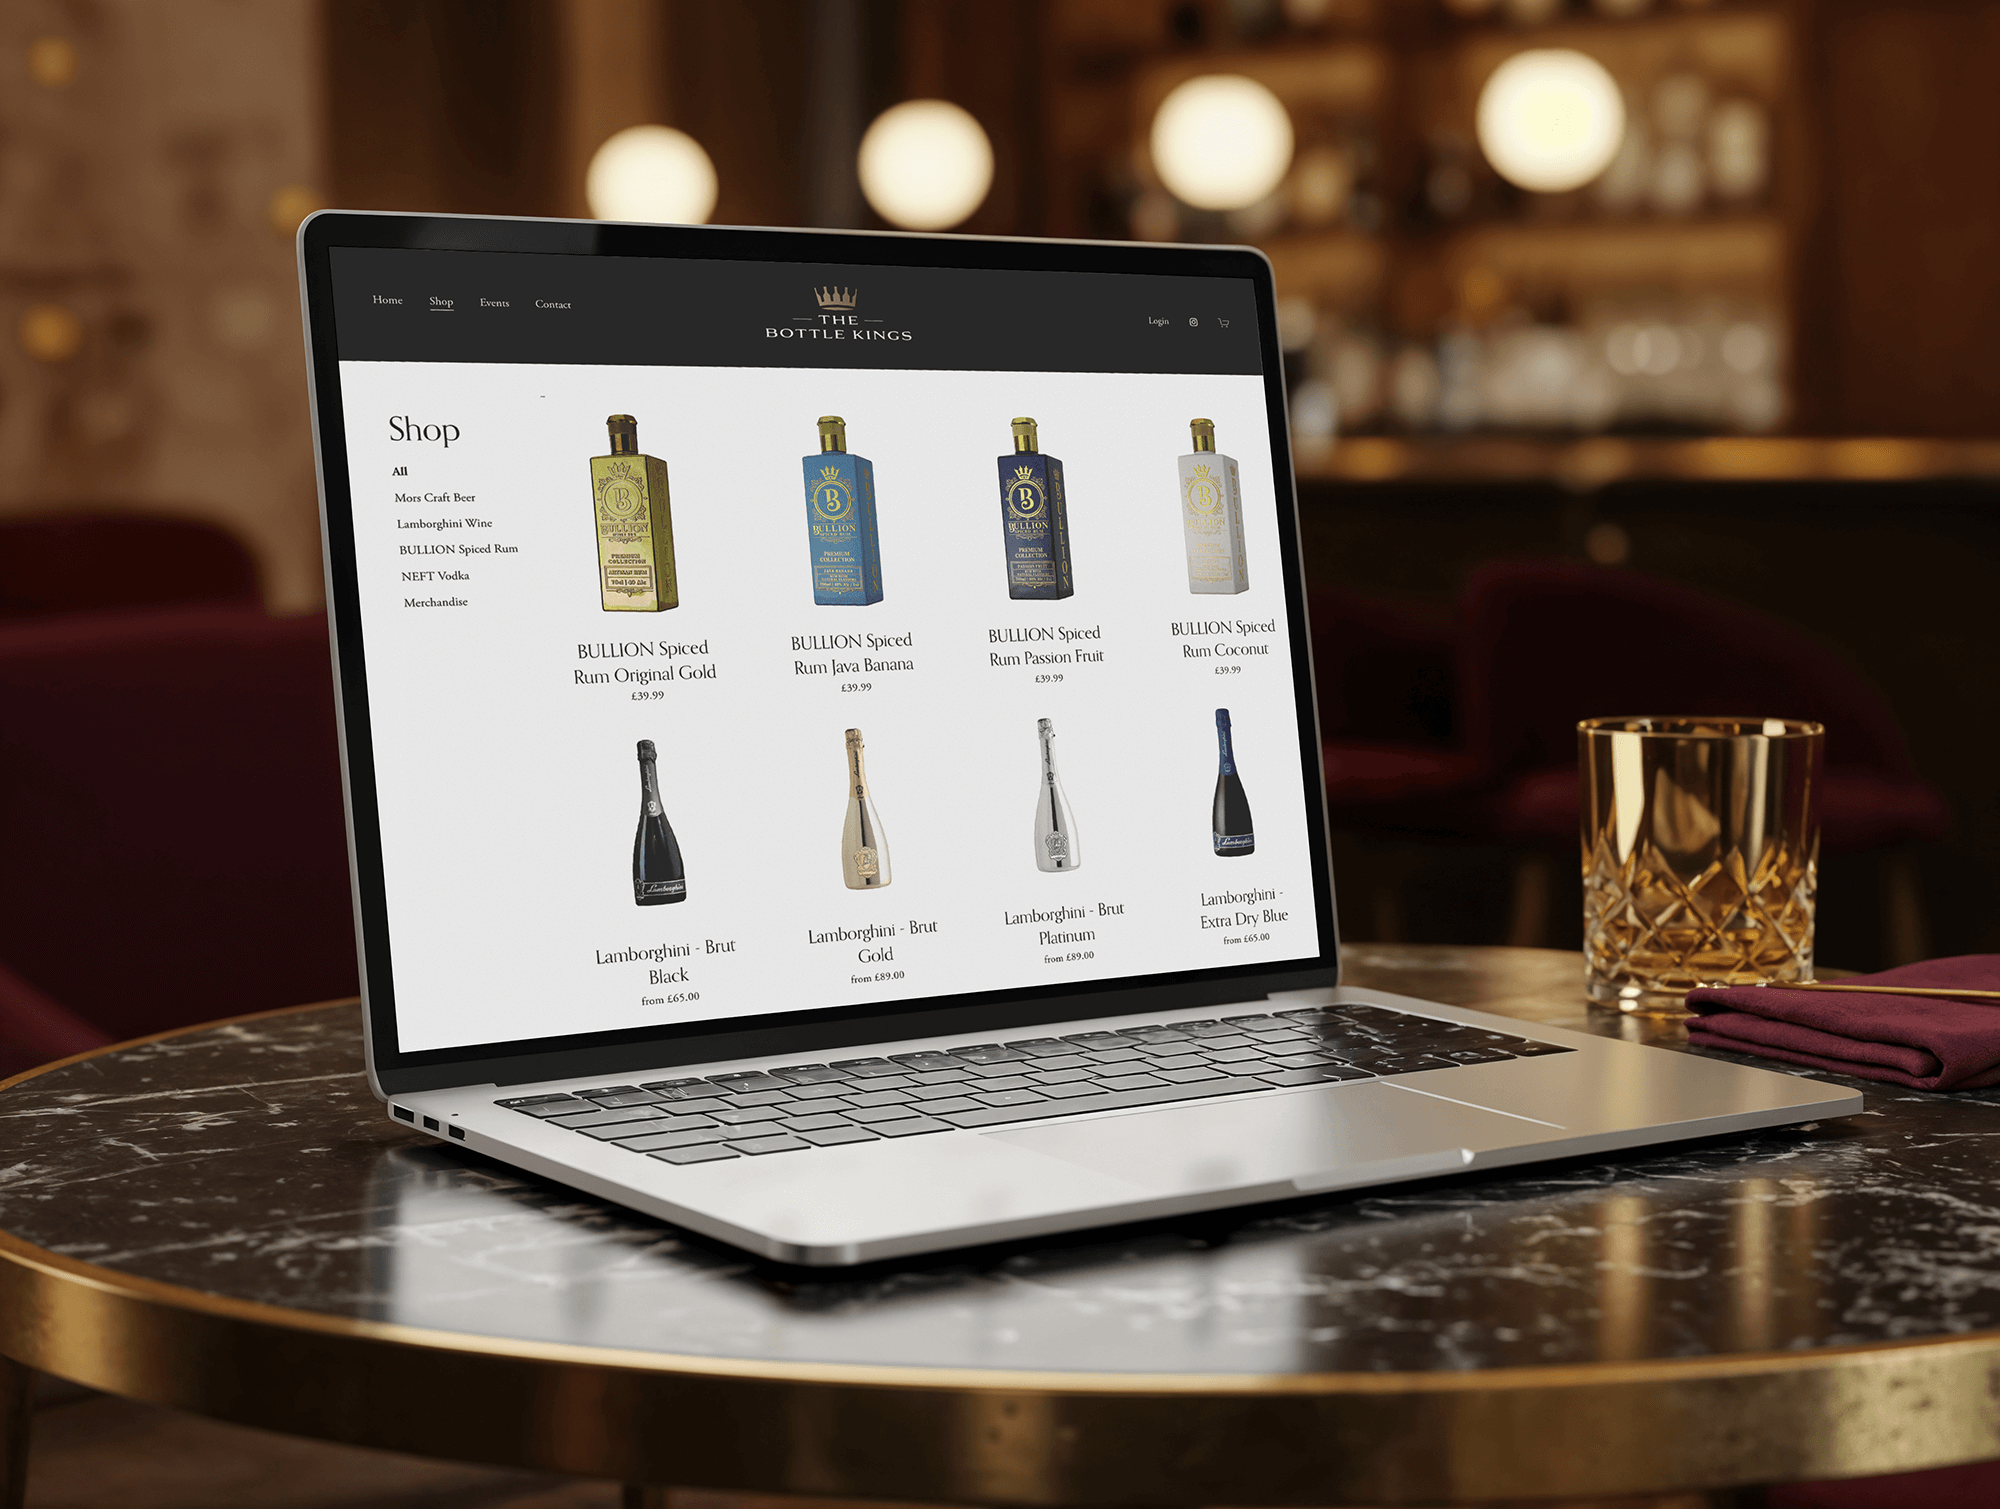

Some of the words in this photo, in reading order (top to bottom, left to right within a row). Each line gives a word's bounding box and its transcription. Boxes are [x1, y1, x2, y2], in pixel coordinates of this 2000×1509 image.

[373, 295, 403, 305] Home
[429, 296, 455, 309] Shop
[480, 297, 510, 308] Events
[535, 299, 572, 309] Contact
[818, 313, 859, 325] THE
[1148, 316, 1170, 328] Login
[765, 327, 846, 340] BOTTLE
[853, 329, 913, 342] KINGS
[389, 415, 461, 449] Shop
[392, 466, 409, 477] All
[395, 493, 422, 503] Mors
[424, 492, 451, 503] Craft
[454, 492, 476, 502] Beer
[397, 518, 463, 532] Lamborghini
[465, 517, 493, 528] Wine
[600, 524, 649, 536] BULLION
[813, 524, 857, 536] BULLION
[1008, 521, 1050, 533] BULLION
[1186, 518, 1226, 530] BULLION
[399, 545, 456, 556] BULLION
[458, 544, 492, 557] Spiced
[494, 543, 519, 554] Rum
[401, 571, 435, 582] NEFT
[438, 570, 470, 581] Vodka
[404, 596, 469, 608] Merchandise
[988, 627, 1054, 644] BULLION
[1058, 625, 1101, 644] Spiced
[1171, 621, 1233, 636] BULLION
[1236, 619, 1276, 637] Spiced
[791, 634, 862, 651] BULLION
[866, 632, 913, 652] Spiced
[577, 642, 654, 660] BULLION
[658, 640, 709, 660] Spiced
[1182, 645, 1212, 658] Rum
[1214, 643, 1269, 658] Coconut
[989, 652, 1021, 667] Rum
[1024, 650, 1072, 665] Passion
[1075, 648, 1104, 663] Fruit
[794, 660, 828, 675] Rum
[832, 659, 860, 677] Java
[863, 657, 915, 672] Banana
[1214, 665, 1242, 675] £39.99
[573, 670, 610, 685] Rum
[614, 666, 675, 686] Original
[678, 663, 717, 680] Gold
[1035, 674, 1064, 684] £39.99
[841, 682, 872, 693] £39.99
[631, 690, 665, 701] £39.99
[1200, 887, 1276, 907] Lamborghini
[1004, 905, 1086, 926] Lamborghini
[1098, 902, 1125, 916] Brut
[1200, 915, 1232, 930] Extra
[1235, 912, 1260, 928] Dry
[1263, 908, 1289, 923] Blue
[808, 924, 896, 945] Lamborghini
[909, 920, 938, 935] Brut
[1039, 930, 1096, 946] Platinum
[1223, 934, 1242, 945] from
[1243, 932, 1270, 944] £65.00
[595, 944, 691, 965] Lamborghini
[705, 939, 736, 955] Brut
[857, 946, 894, 964] Gold
[1044, 953, 1065, 964] from
[1066, 950, 1095, 962] £89.00
[649, 967, 690, 985] Black
[850, 974, 873, 984] from
[874, 970, 905, 983] £89.00
[641, 995, 665, 1006] from
[667, 991, 700, 1004] £65.00
